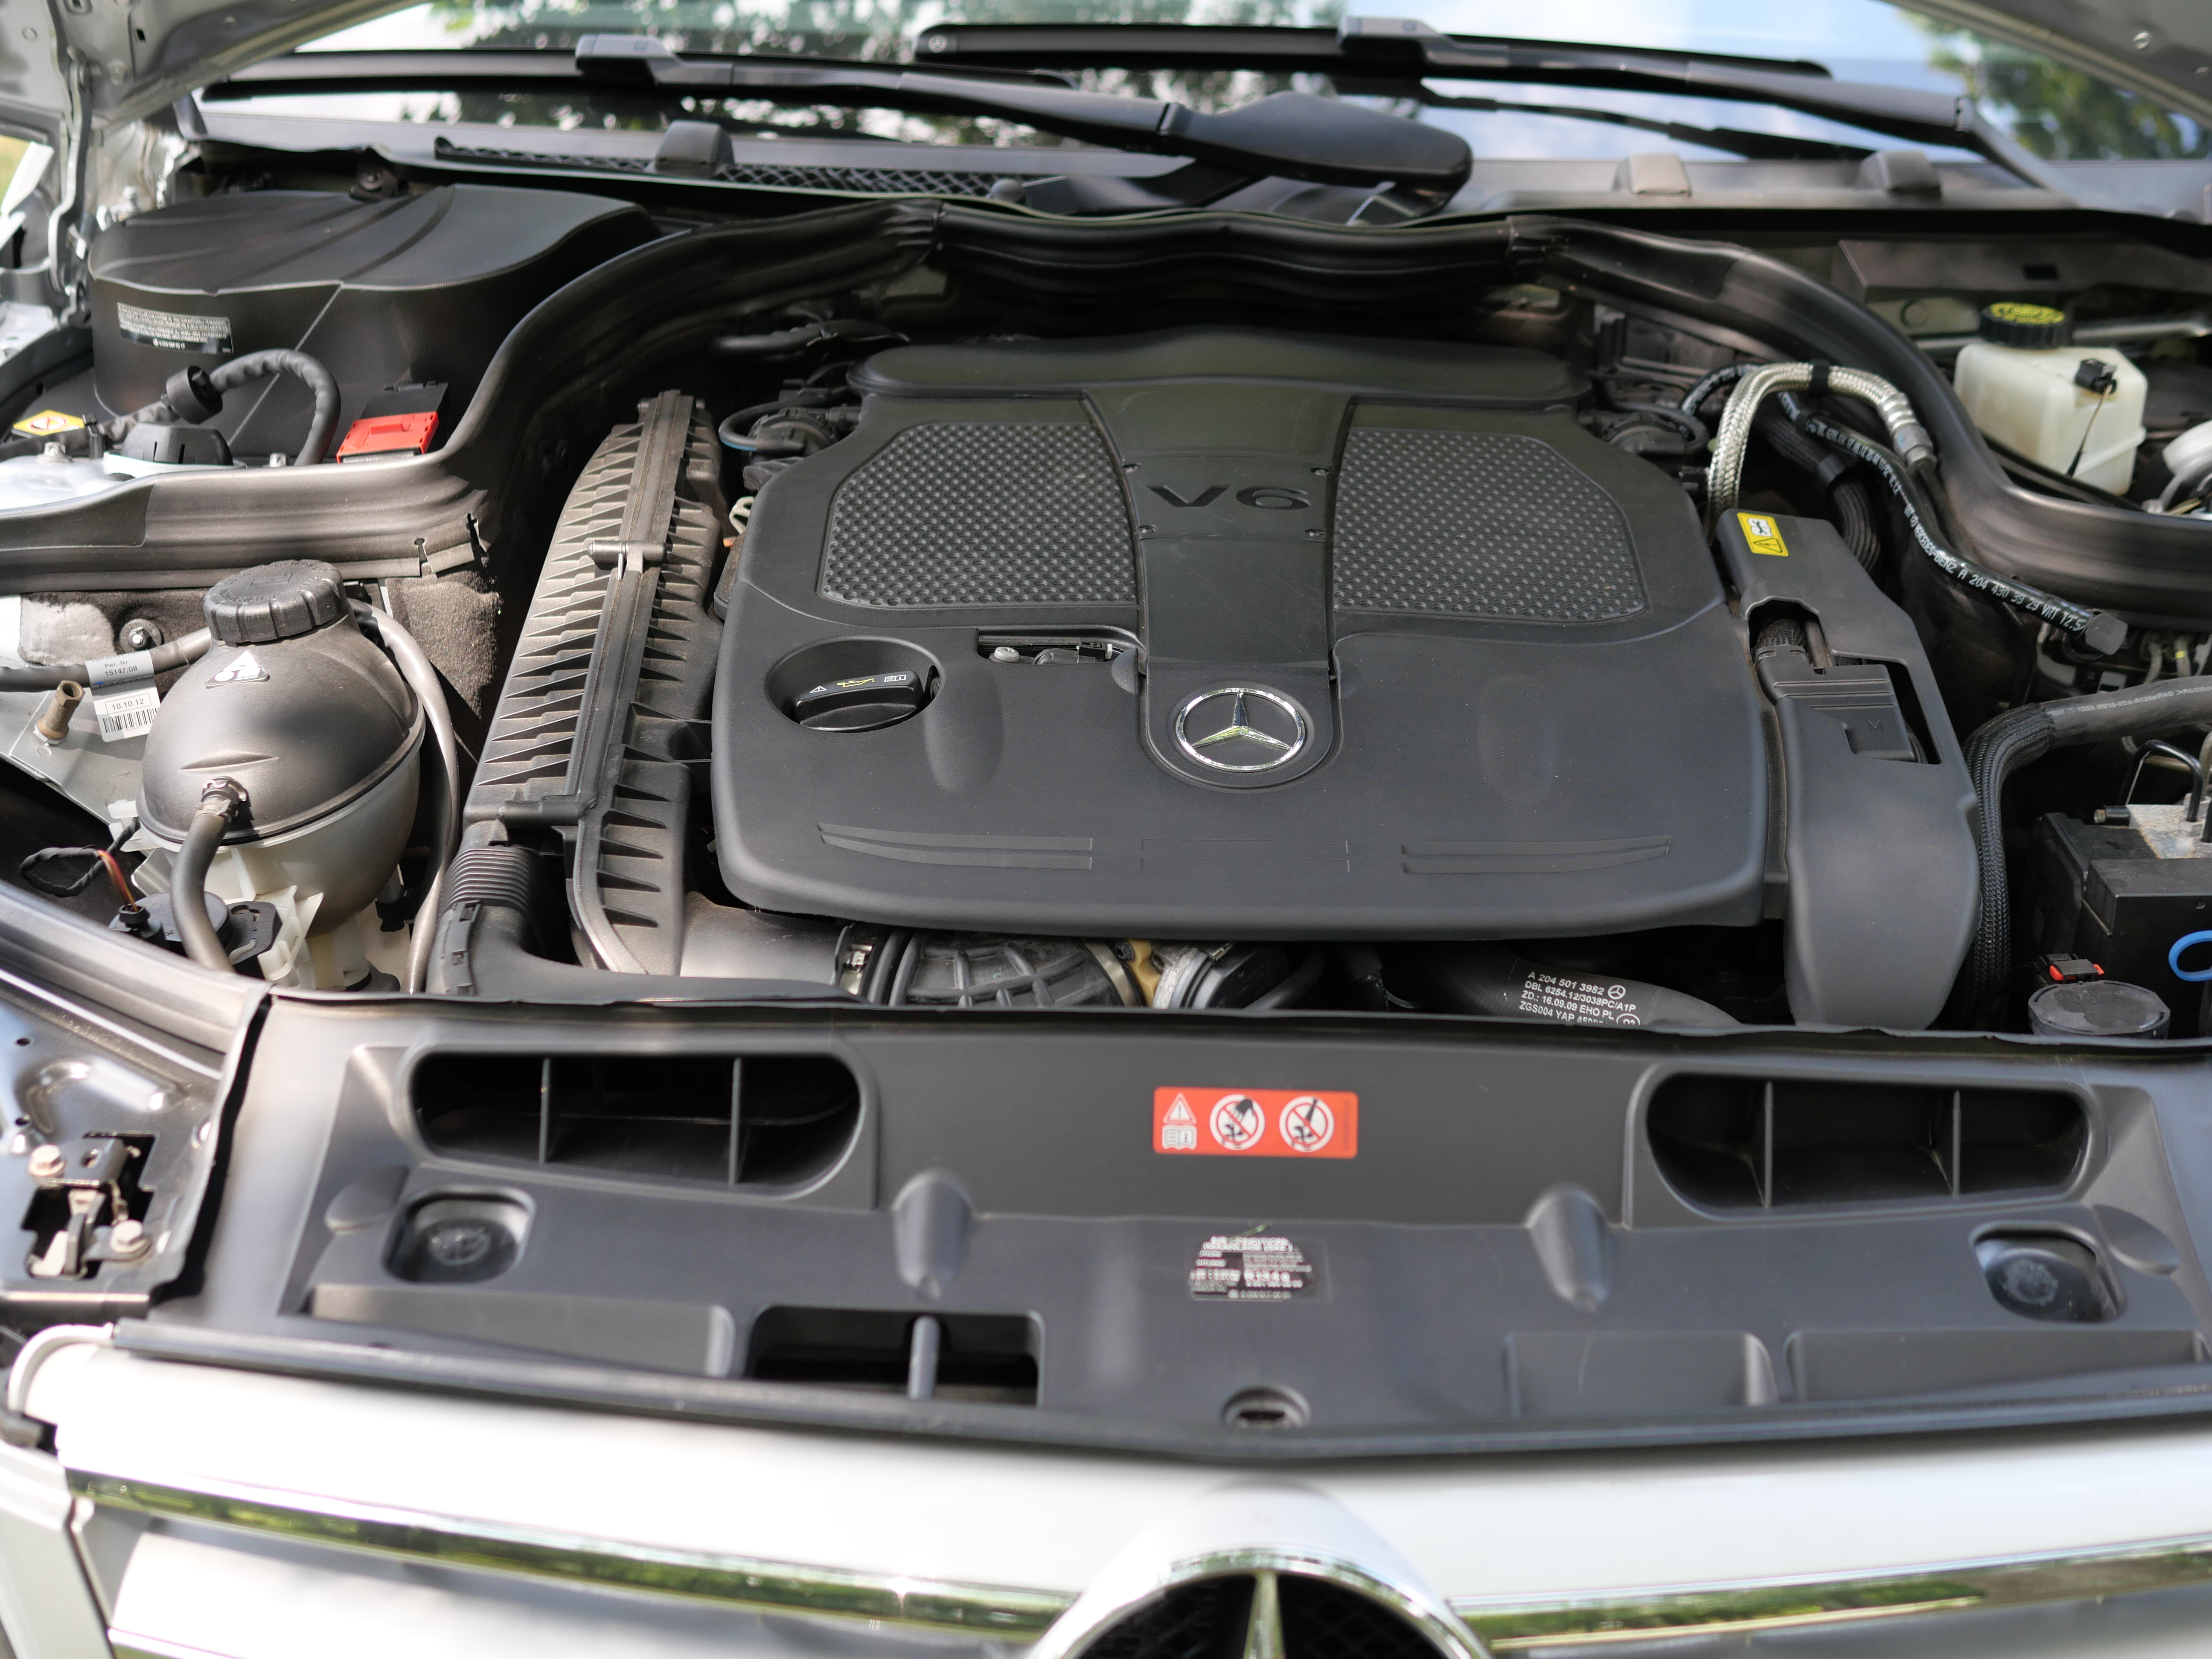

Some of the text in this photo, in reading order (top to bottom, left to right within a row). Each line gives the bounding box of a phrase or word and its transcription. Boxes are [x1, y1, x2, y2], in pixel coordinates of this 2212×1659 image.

[1147, 485, 1310, 510] V6
[1913, 523, 1958, 574] MERCEDES-BENZ
[1957, 568, 1968, 580] A
[1968, 574, 1988, 590] 204
[1991, 582, 2008, 598] 430
[105, 665, 138, 677] 15147/08
[112, 698, 144, 710] 10.10.12
[1525, 981, 1543, 992] DBL
[1527, 971, 1605, 995] A 204 501 3982
[1519, 1001, 1553, 1017] ZGS004
[1555, 1010, 1575, 1022] YAP
[1521, 990, 1540, 1002] ZD.:
[1542, 995, 1578, 1011] 16.09.09
[1579, 1005, 1600, 1017] EHO
[1602, 1011, 1615, 1020] PL
[1243, 1271, 1291, 1281] R134a
